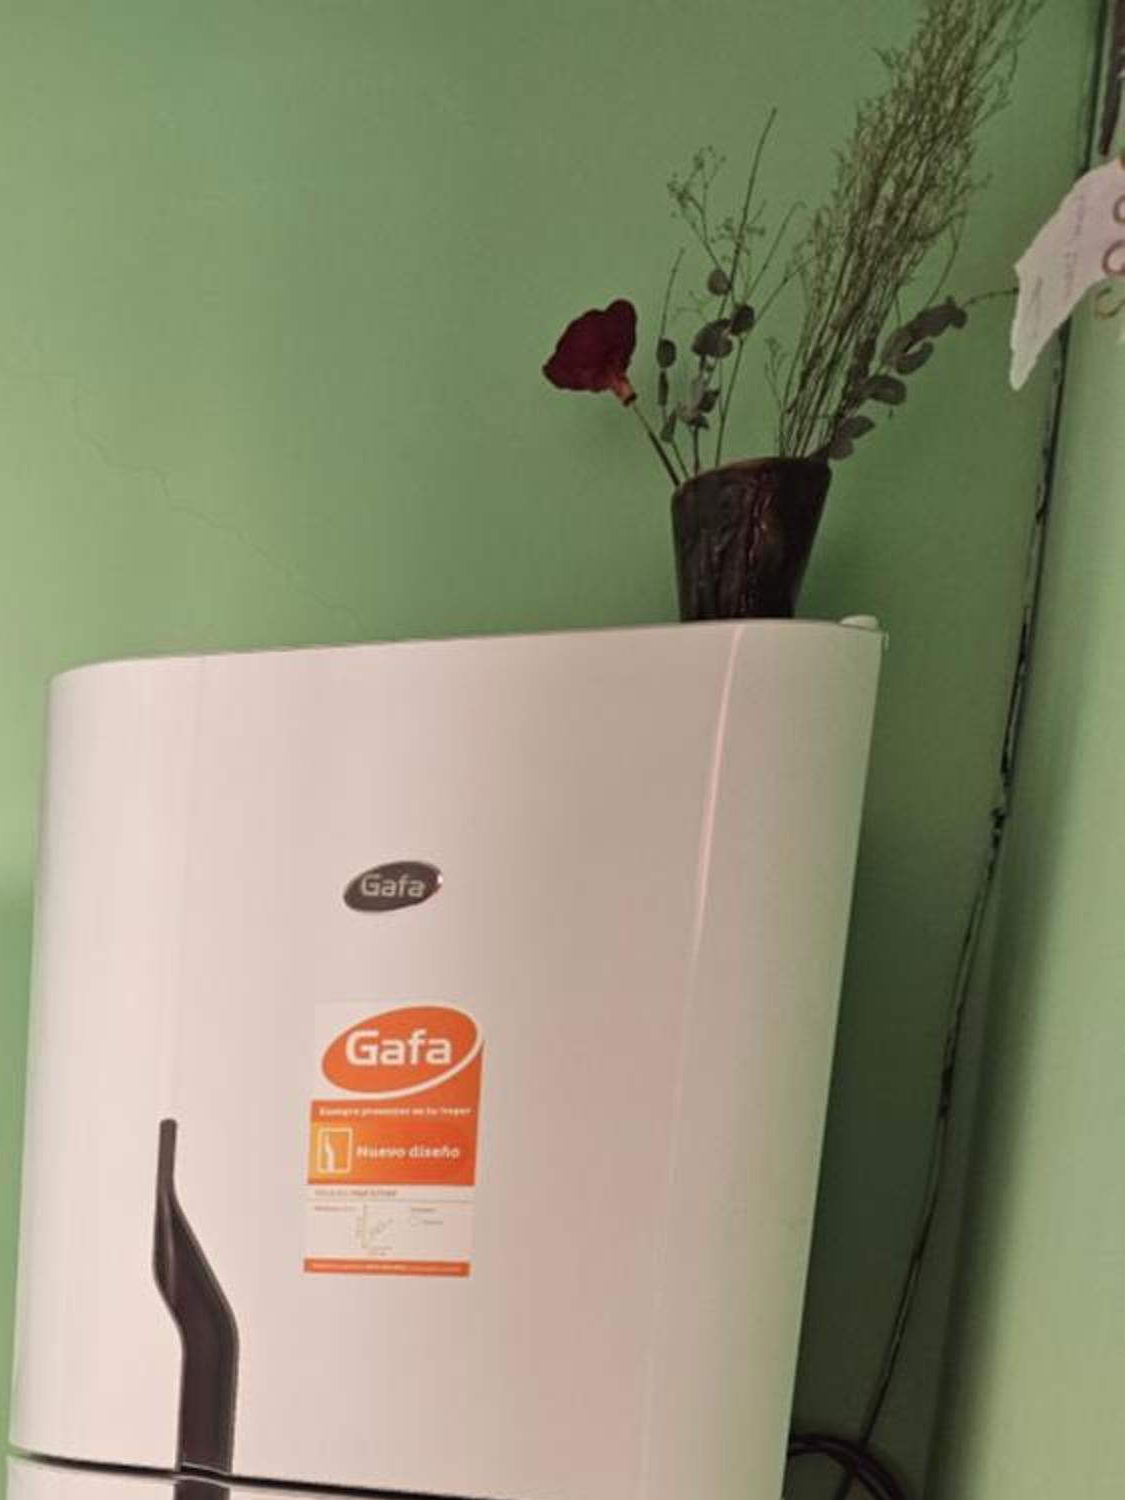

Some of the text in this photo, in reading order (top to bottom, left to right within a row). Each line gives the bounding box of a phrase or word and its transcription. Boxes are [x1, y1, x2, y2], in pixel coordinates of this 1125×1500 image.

[359, 872, 426, 899] Gafa
[345, 1029, 453, 1067] Gafa
[356, 1145, 460, 1159] Nuevo diseño
